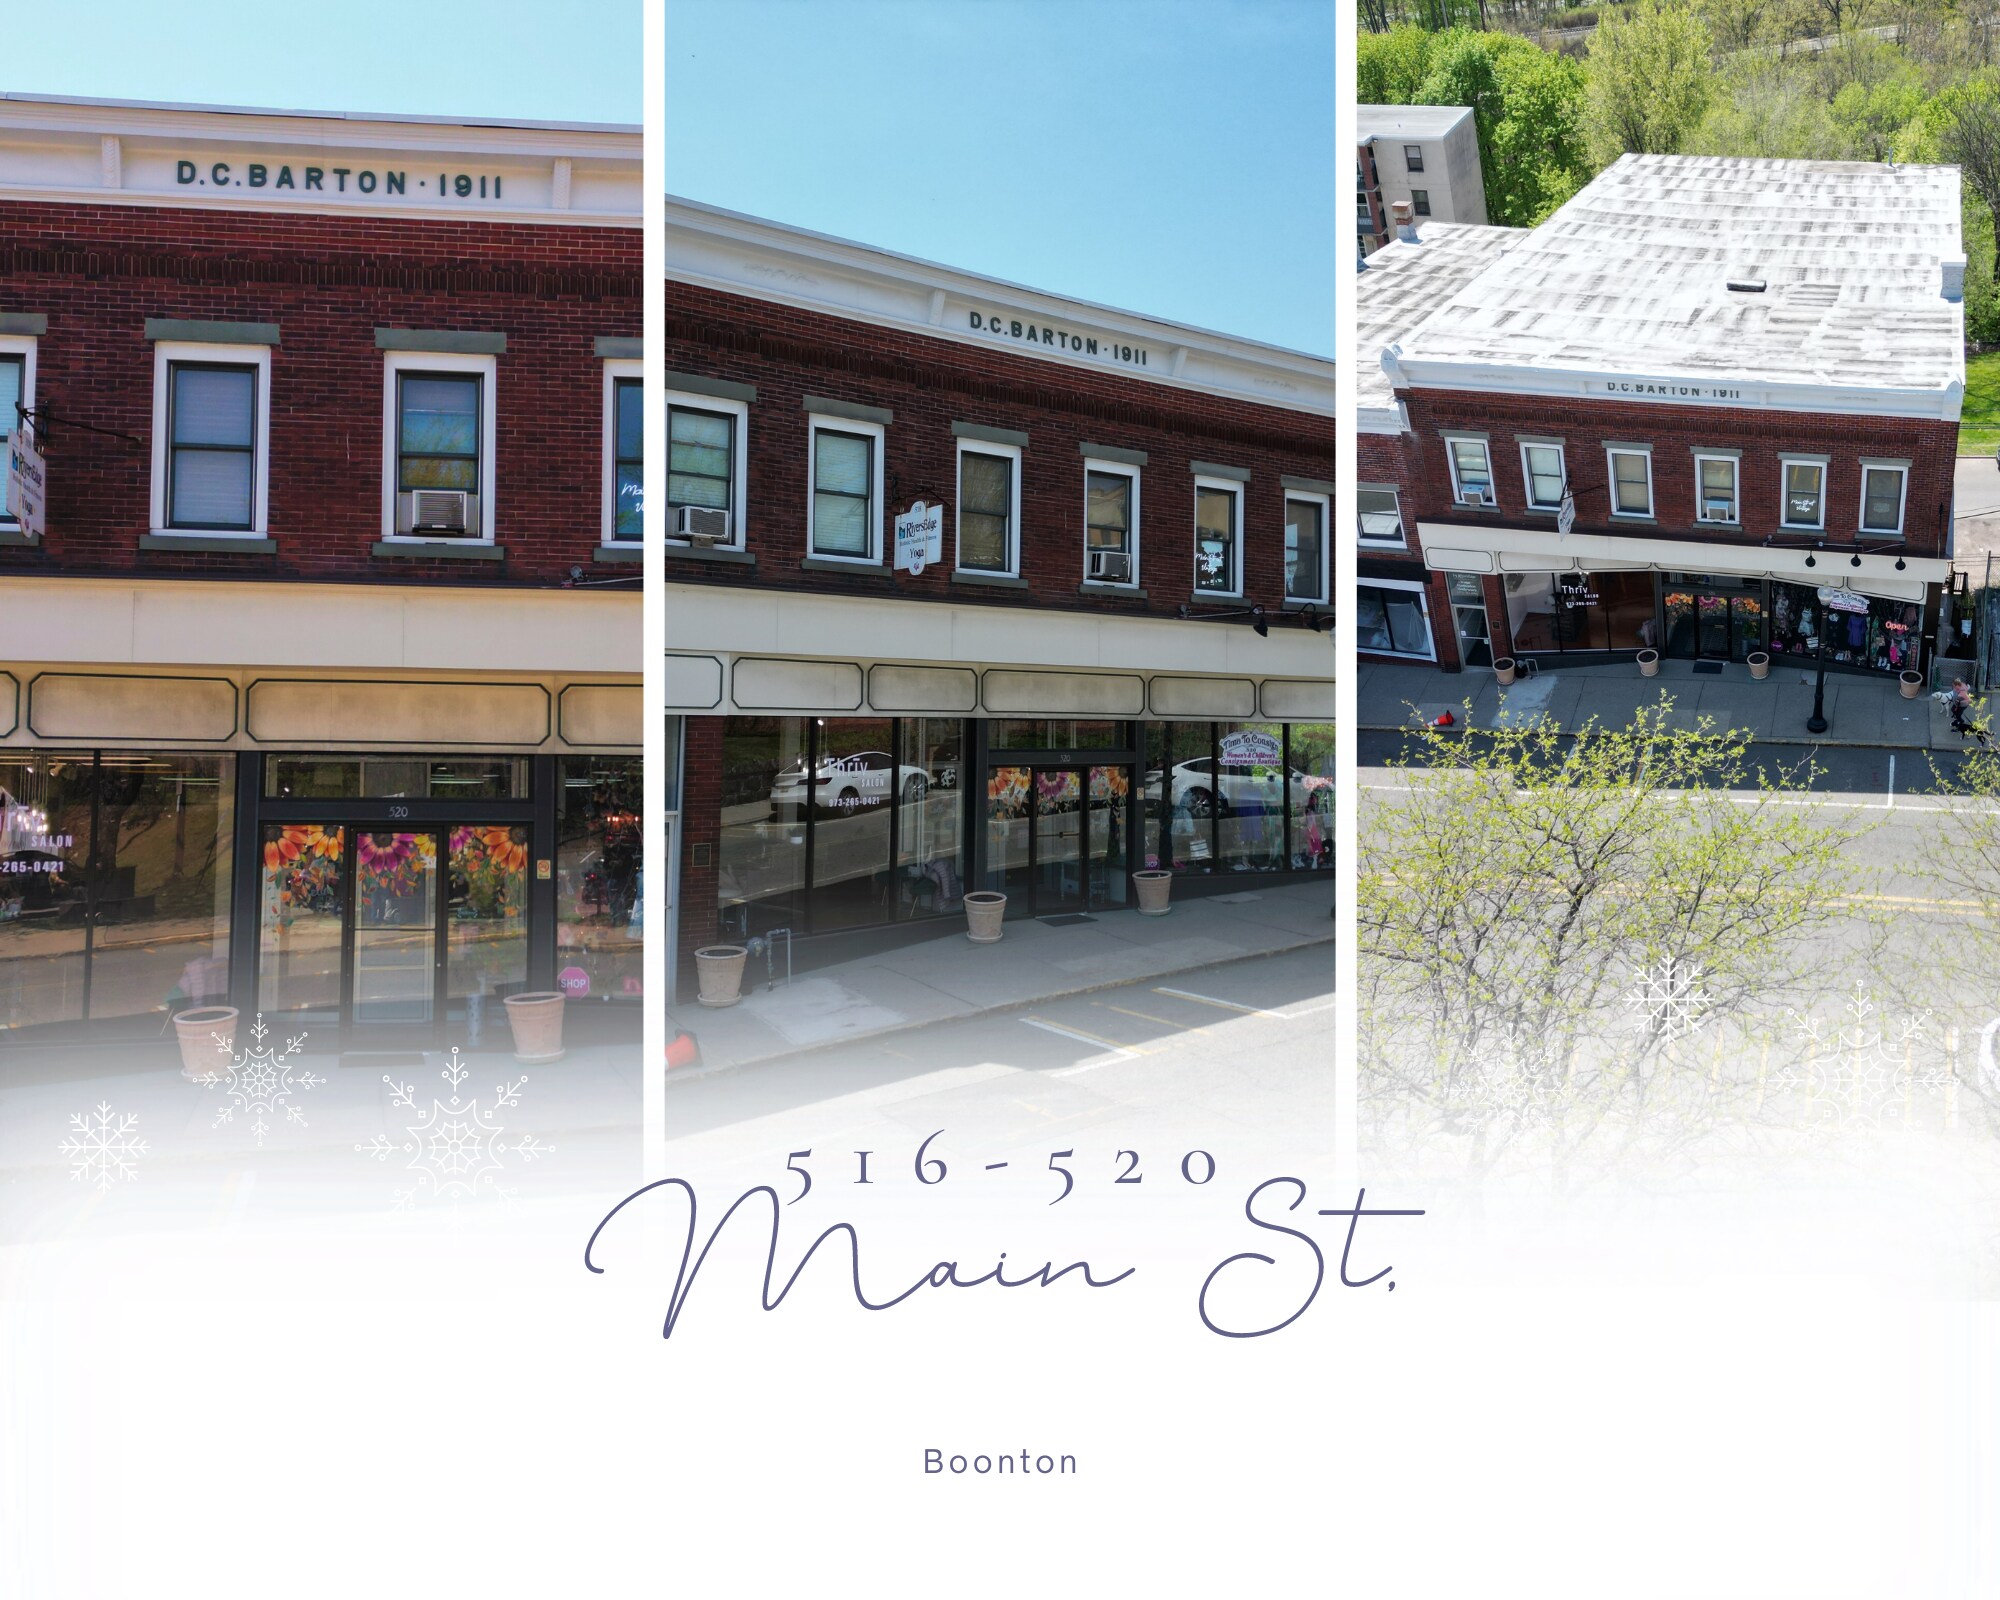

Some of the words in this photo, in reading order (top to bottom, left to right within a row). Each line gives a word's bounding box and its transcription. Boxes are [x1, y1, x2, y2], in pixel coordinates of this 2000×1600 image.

[439, 172, 502, 199] 1911
[1113, 343, 1147, 366] 1911
[910, 548, 925, 559] Yoga
[1885, 620, 1909, 631] Open
[1241, 734, 1251, 744] To
[1251, 734, 1279, 752] Consign
[861, 778, 885, 788] SALON
[828, 796, 880, 807] 973-265-0421
[388, 806, 409, 818] 520
[31, 835, 73, 848] SALON
[560, 978, 586, 989] SHOP
